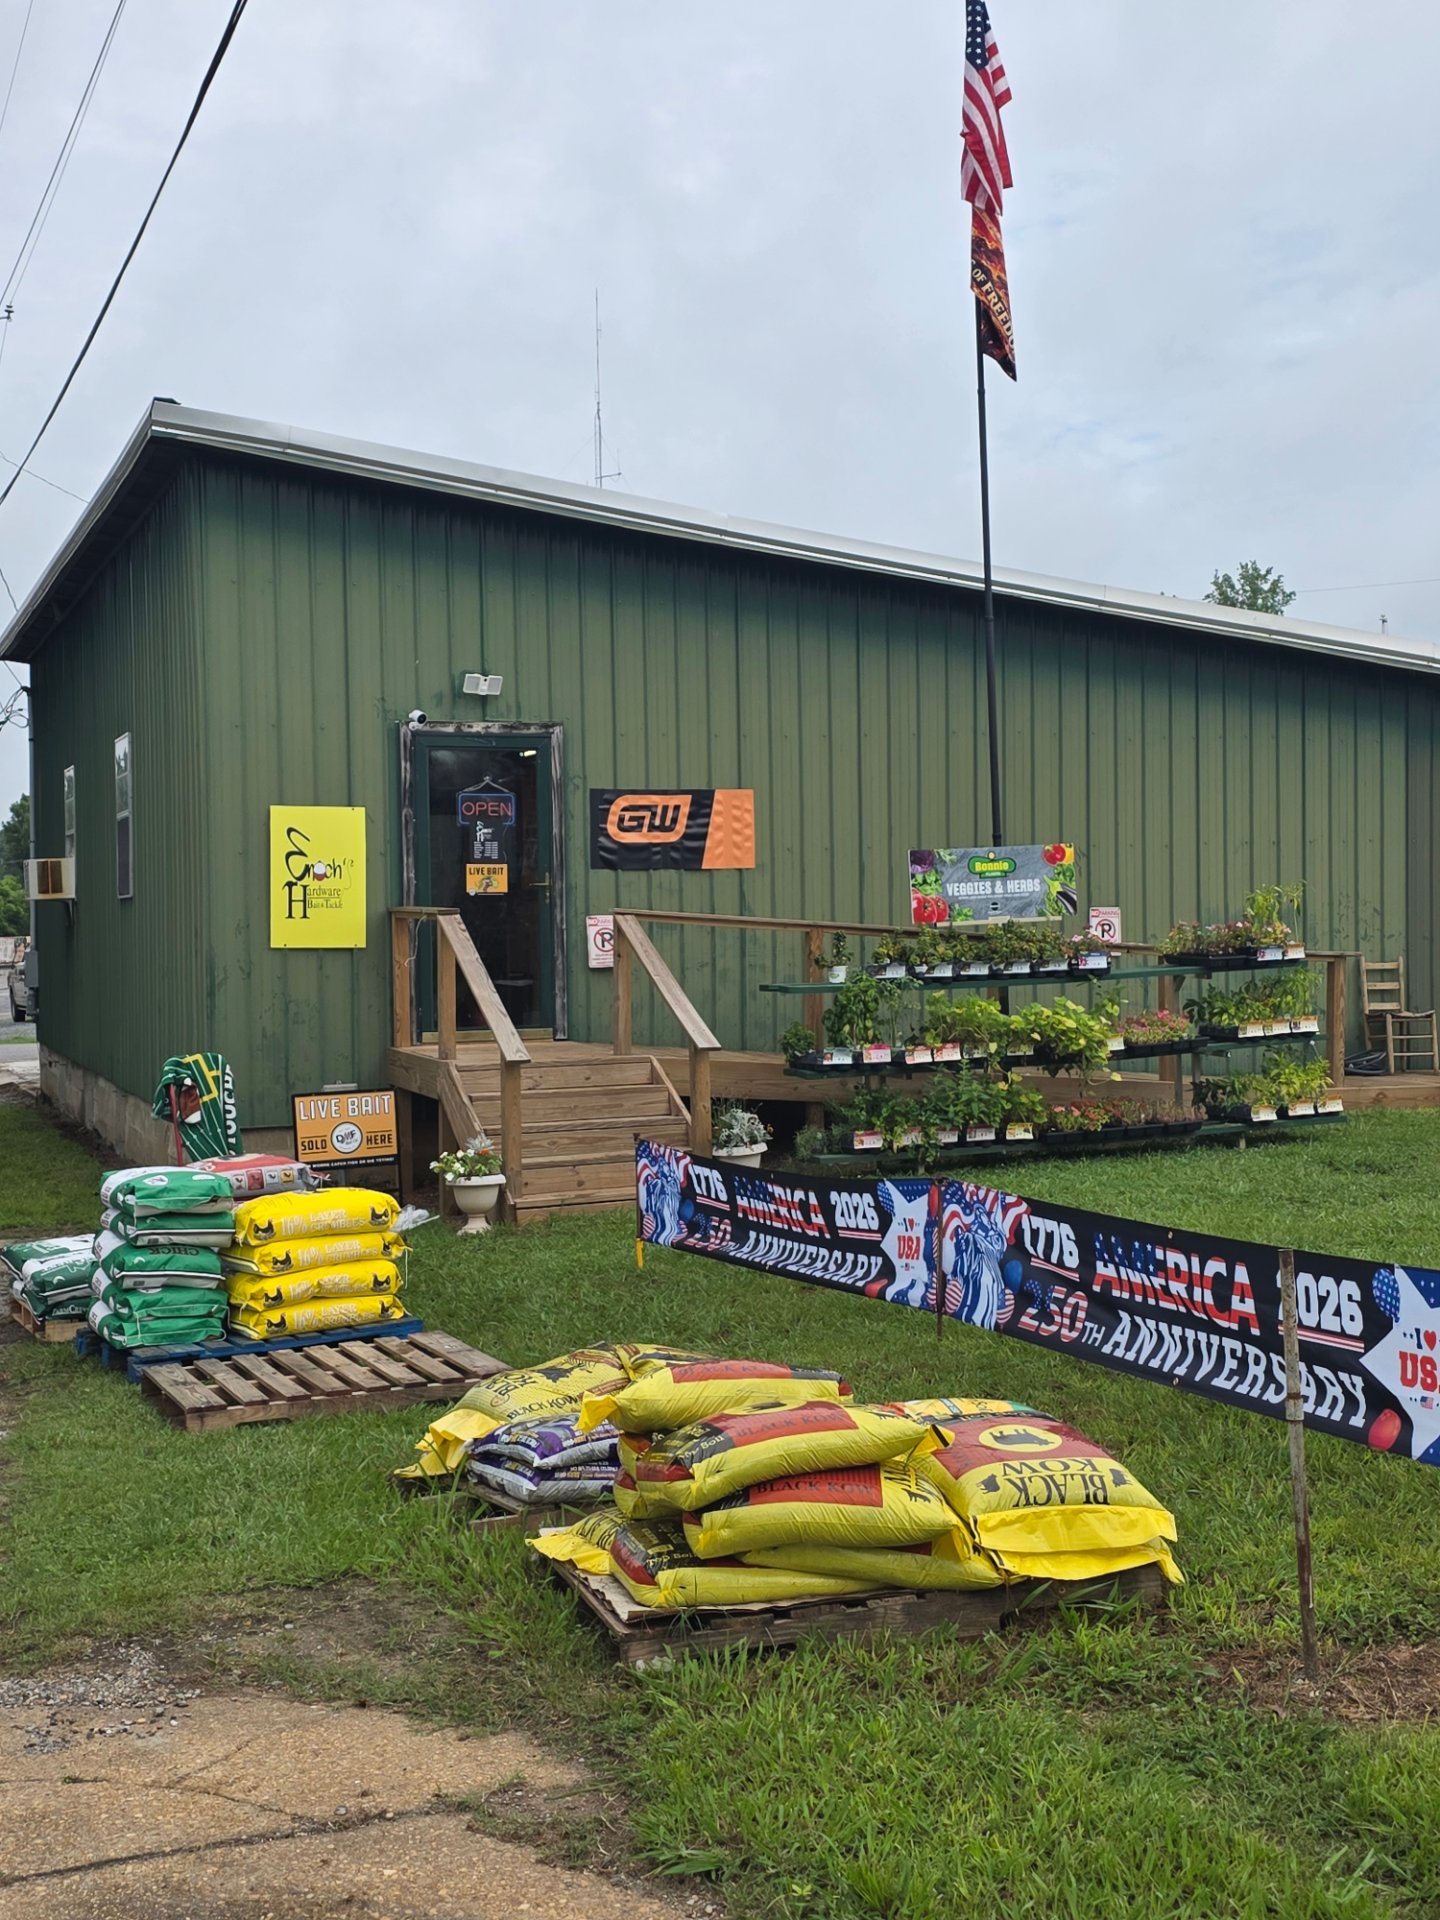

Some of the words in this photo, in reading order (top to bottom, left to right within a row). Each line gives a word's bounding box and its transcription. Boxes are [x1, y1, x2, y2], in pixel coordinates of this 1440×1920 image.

[972, 268, 987, 283] OF
[462, 802, 511, 816] OPEN
[468, 868, 485, 876] LIVE
[487, 867, 504, 875] BAIT
[975, 861, 1009, 871] Bonnie
[947, 881, 992, 896] VEGGIES
[994, 880, 1004, 894] &
[1006, 878, 1041, 892] HERBS
[282, 881, 341, 919] Hardware
[307, 899, 320, 909] Bait
[325, 899, 343, 909] Tackle
[300, 1098, 341, 1120] LIVE
[347, 1095, 391, 1117] BAIT
[301, 1139, 327, 1151] SOLO
[366, 1133, 393, 1145] HERE
[688, 1164, 728, 1202] 1776
[734, 1176, 831, 1239] AMERICA
[830, 1191, 880, 1230] 2026
[310, 1209, 346, 1222] LAYER
[282, 1216, 307, 1236] 16%
[311, 1218, 365, 1231] CRUMBLES
[149, 1247, 199, 1256] CHICK
[298, 1246, 323, 1266] 16%
[325, 1240, 360, 1252] LAYER
[896, 1235, 921, 1261] USA
[729, 1231, 883, 1287] ANNIVERSARY
[1021, 1213, 1080, 1269] 1776
[1092, 1231, 1261, 1336] AMERICA
[294, 1310, 319, 1329] 16%
[321, 1304, 356, 1316] LAYER
[1415, 1328, 1423, 1350] I
[1101, 1309, 1367, 1428] ANNIVERSARY
[1399, 1350, 1440, 1393] US
[507, 1400, 548, 1420] BLACK
[549, 1394, 580, 1410] KOW
[736, 1418, 796, 1437] BLACK
[801, 1412, 843, 1427] KOW
[1002, 1457, 1097, 1478] KOW
[757, 1481, 820, 1494] BLACK
[827, 1481, 873, 1496] KOW
[1007, 1472, 1110, 1508] BLACK
